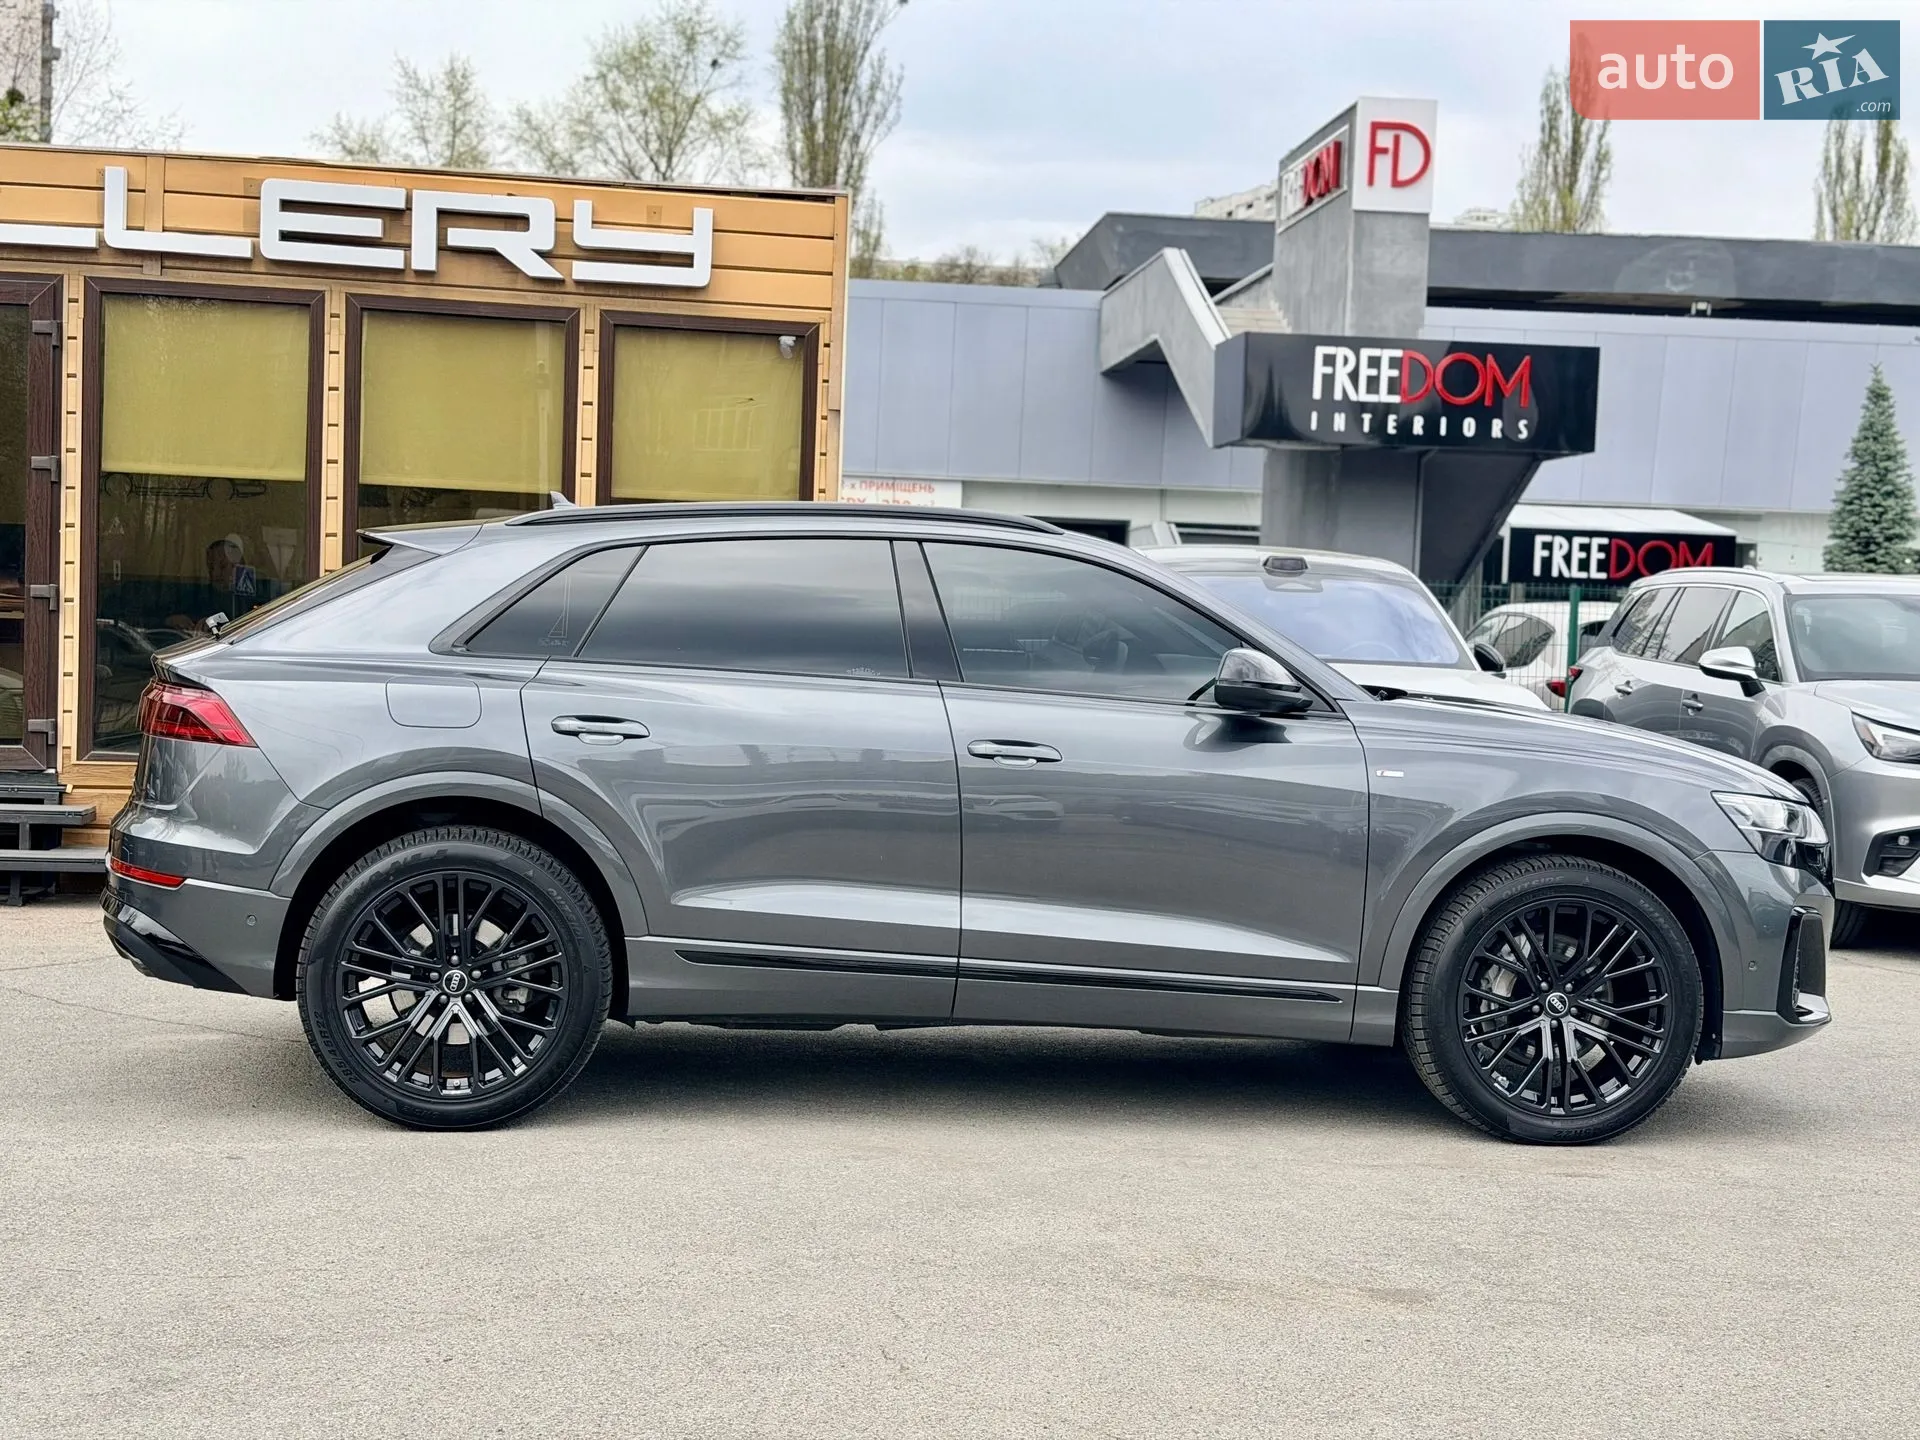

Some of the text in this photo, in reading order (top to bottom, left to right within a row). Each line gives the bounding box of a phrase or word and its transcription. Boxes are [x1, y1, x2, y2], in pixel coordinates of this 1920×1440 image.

[1367, 120, 1431, 188] FD
[1312, 345, 1532, 408] FREEDOM
[1310, 410, 1529, 440] INTERIORS
[1533, 534, 1714, 580] FREEDOM
